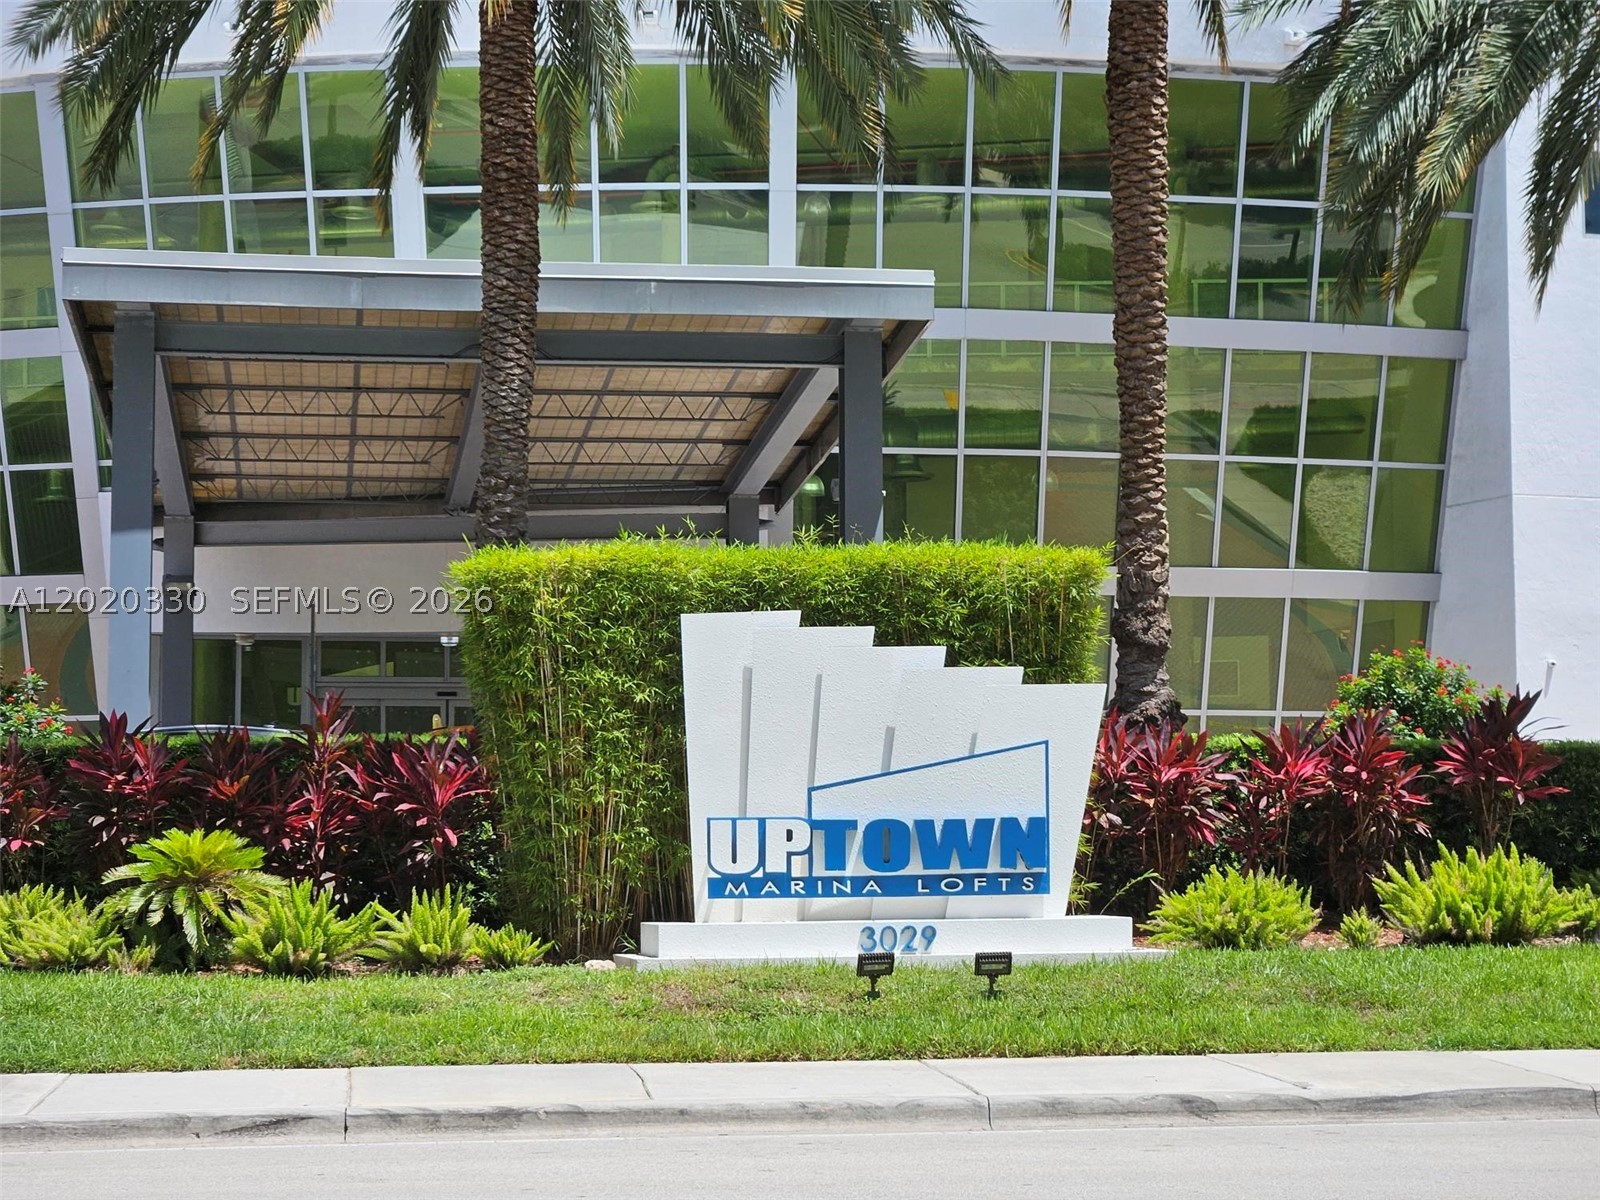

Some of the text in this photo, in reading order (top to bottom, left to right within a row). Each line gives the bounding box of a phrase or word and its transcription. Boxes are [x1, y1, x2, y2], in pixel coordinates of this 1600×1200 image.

[708, 817, 1046, 874] UPTOWN
[724, 877, 1035, 896] MARINA LOFTS
[860, 924, 937, 953] 3029
